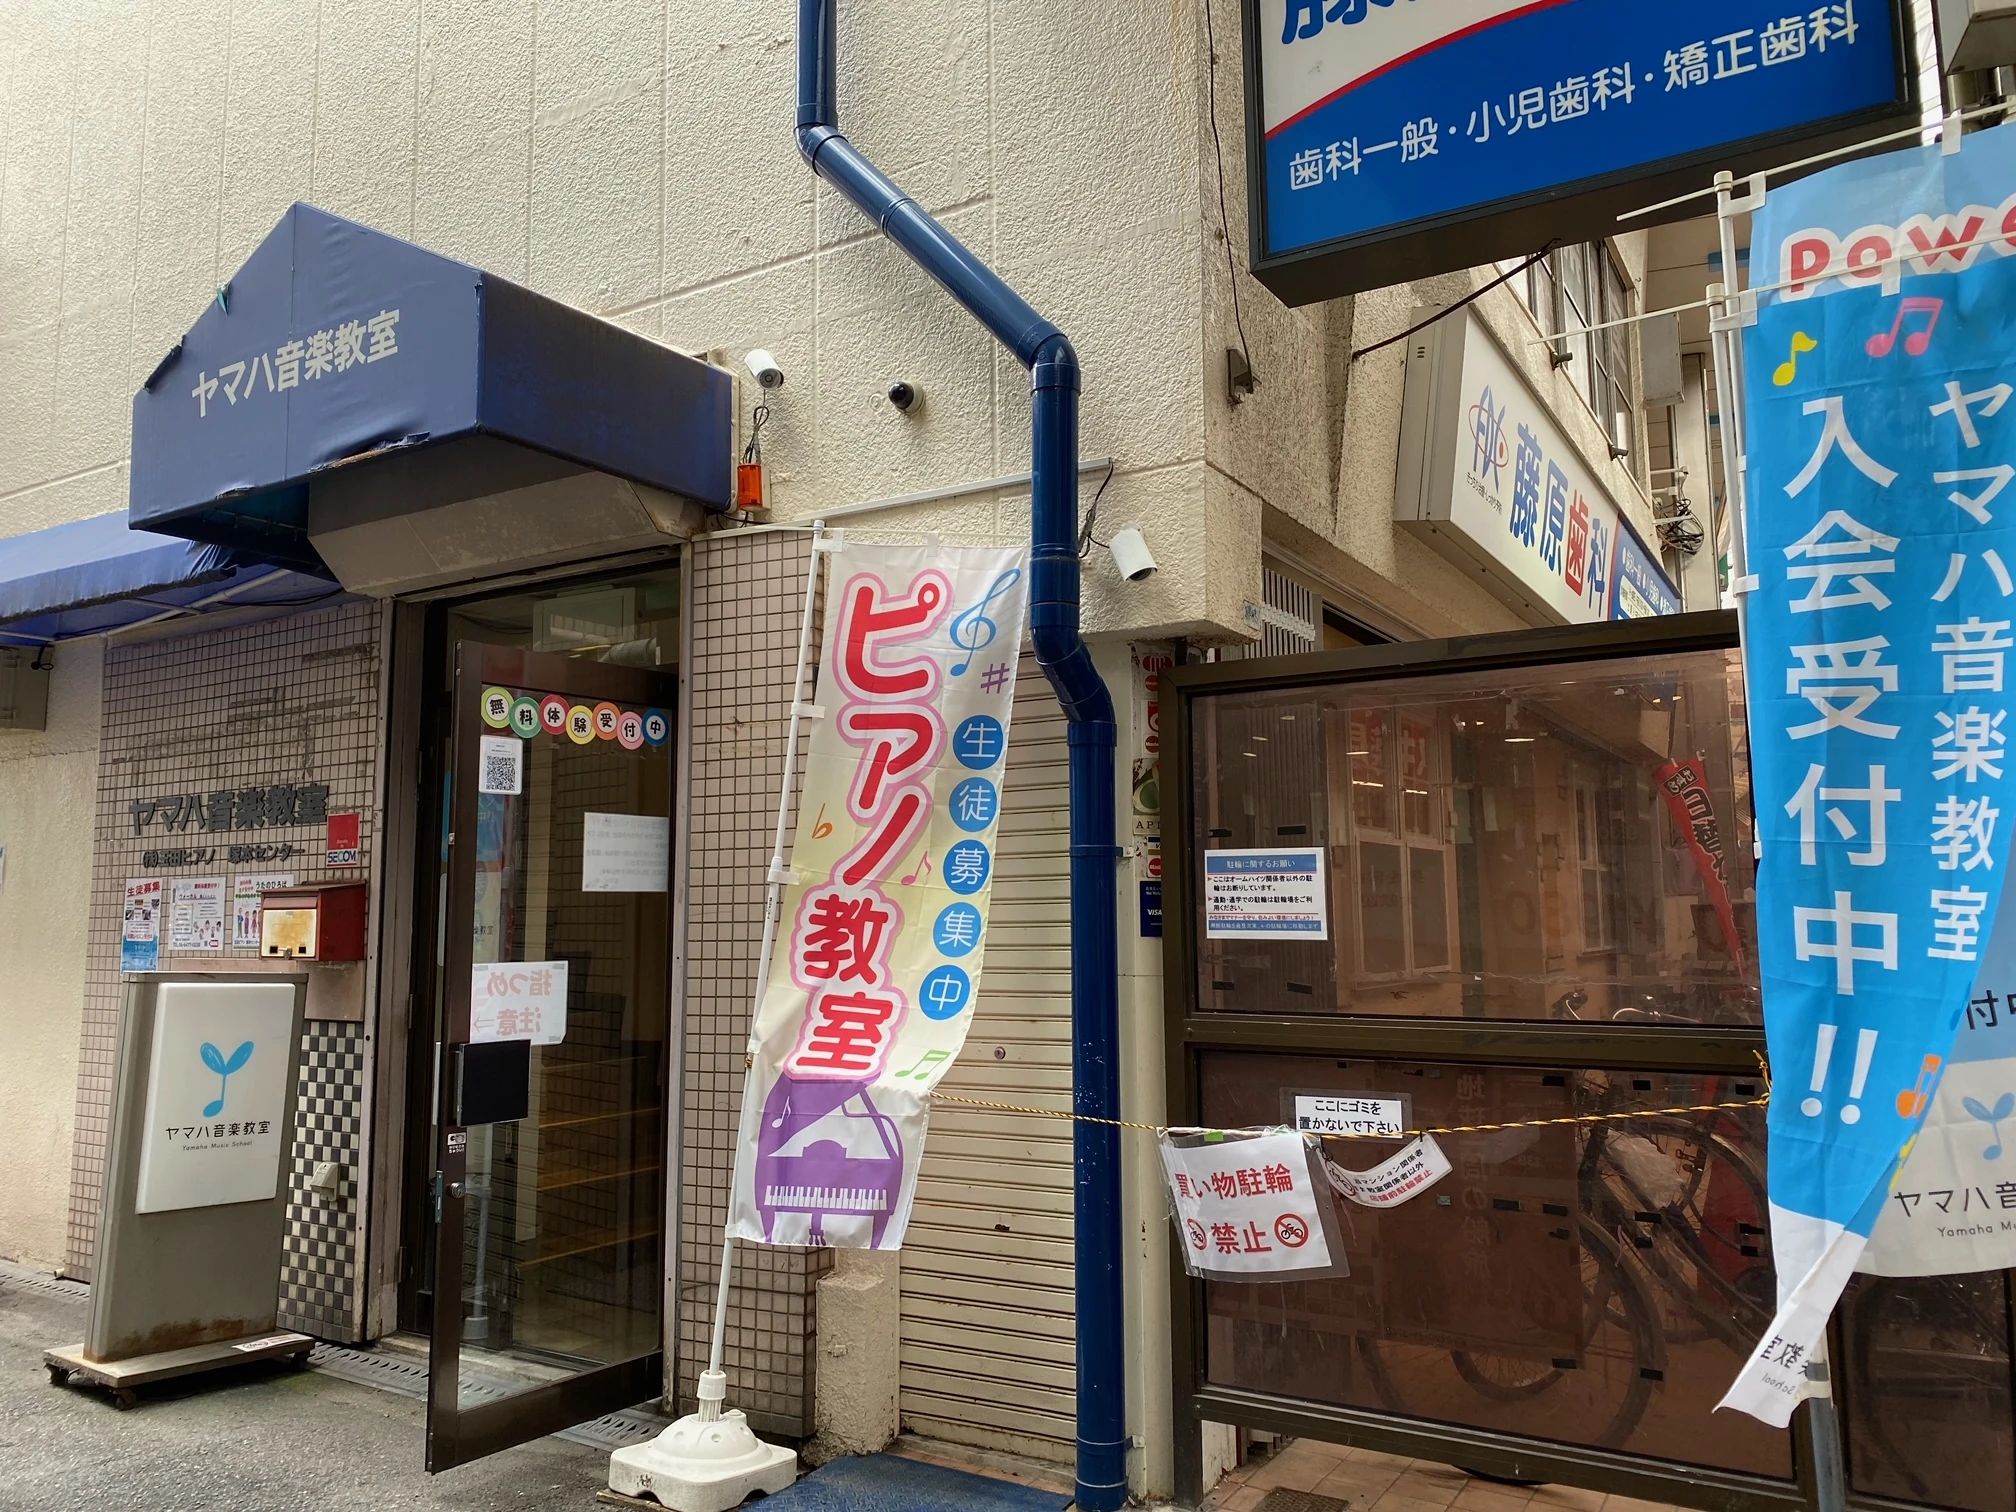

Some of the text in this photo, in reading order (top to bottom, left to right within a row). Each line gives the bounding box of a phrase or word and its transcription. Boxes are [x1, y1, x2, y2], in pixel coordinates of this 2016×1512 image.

[1289, 3, 1858, 190] 歯科一般・小児歯科・矯正歯科
[191, 309, 400, 418] ヤマハ音楽教室
[1509, 422, 1608, 618] 藤原歯科
[1928, 381, 2016, 961] ヤマハ音楽教室
[489, 698, 661, 738] 無料体験受付中
[129, 783, 330, 836] ヤマハ音楽教室
[796, 582, 940, 1070] ピアノ教室
[327, 849, 357, 863] SECOM
[928, 722, 996, 1012] 生徒募集中
[1226, 859, 1296, 869] 駐輪に関するお願い
[127, 881, 160, 897] 生徒募集
[1213, 904, 1244, 912] 用ください。
[1299, 1116, 1400, 1134] 置かないで下さい
[1315, 1100, 1382, 1115] ここにゴミを
[165, 1120, 271, 1141] ヤマハ音楽教室
[182, 1143, 208, 1151] Yamaha
[232, 1140, 252, 1148] School
[1175, 1163, 1294, 1200] 買い物駐輪
[1211, 1220, 1273, 1255] 禁止
[1937, 1223, 1993, 1238] Yamaha
